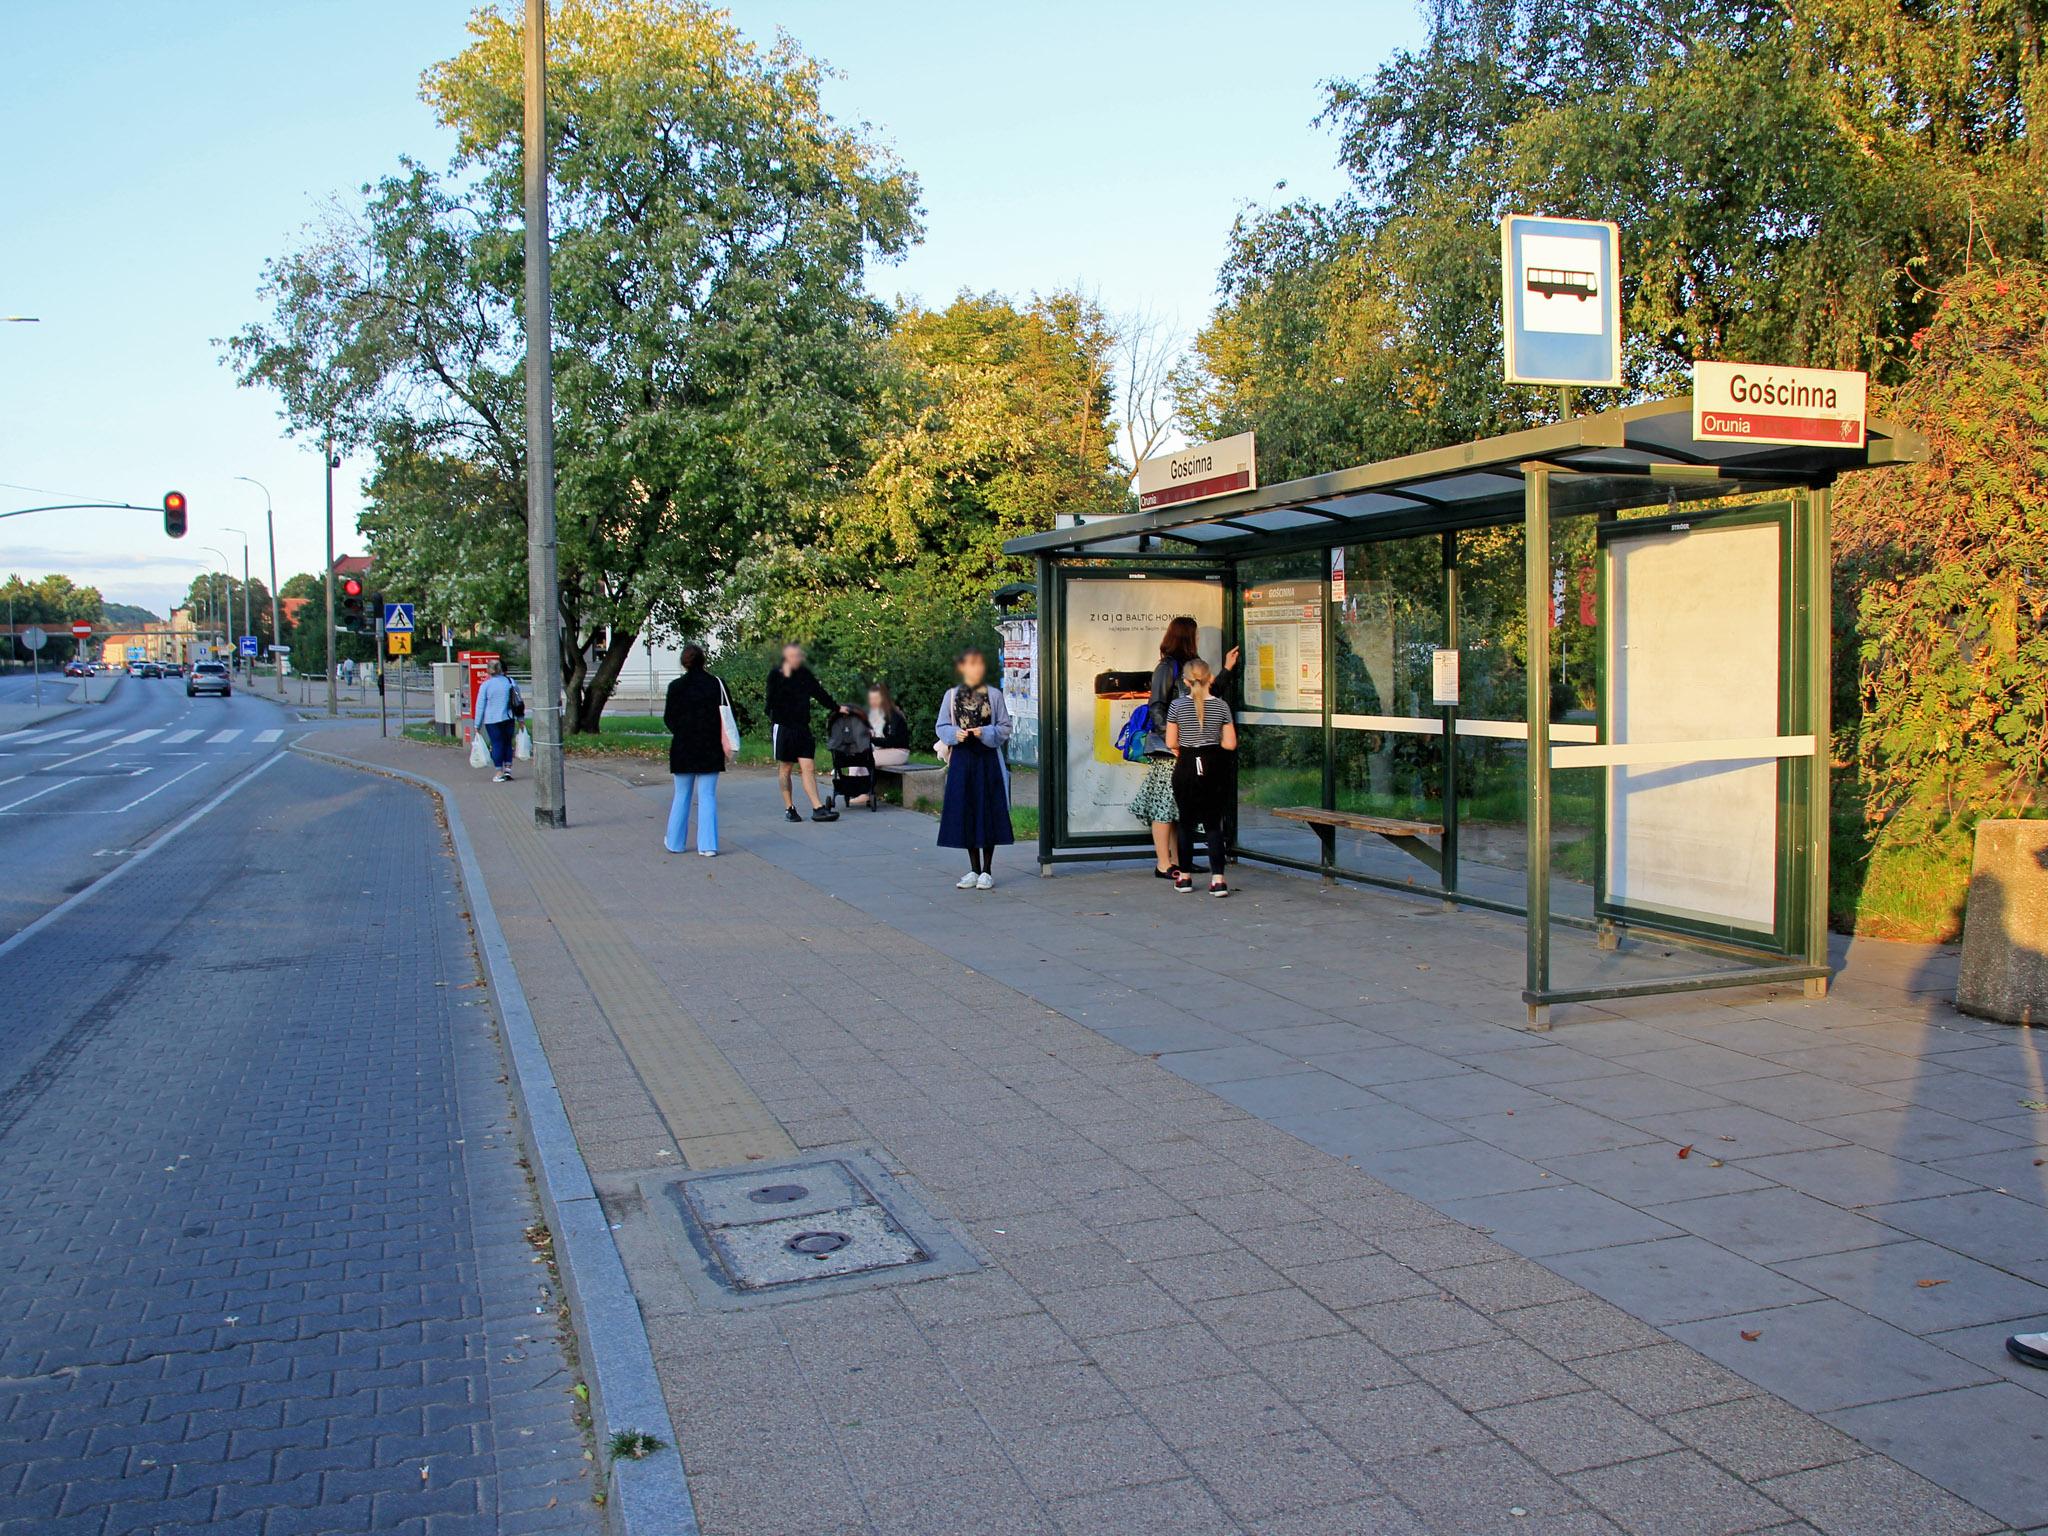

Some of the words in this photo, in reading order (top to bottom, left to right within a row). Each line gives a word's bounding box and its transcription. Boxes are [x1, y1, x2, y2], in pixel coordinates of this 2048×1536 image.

[1730, 374, 1837, 409] Gościnna
[1704, 415, 1750, 433] Orunia
[1170, 455, 1212, 479] Gościnna
[1141, 494, 1157, 507] Orunia
[1126, 613, 1154, 621] BALTIC
